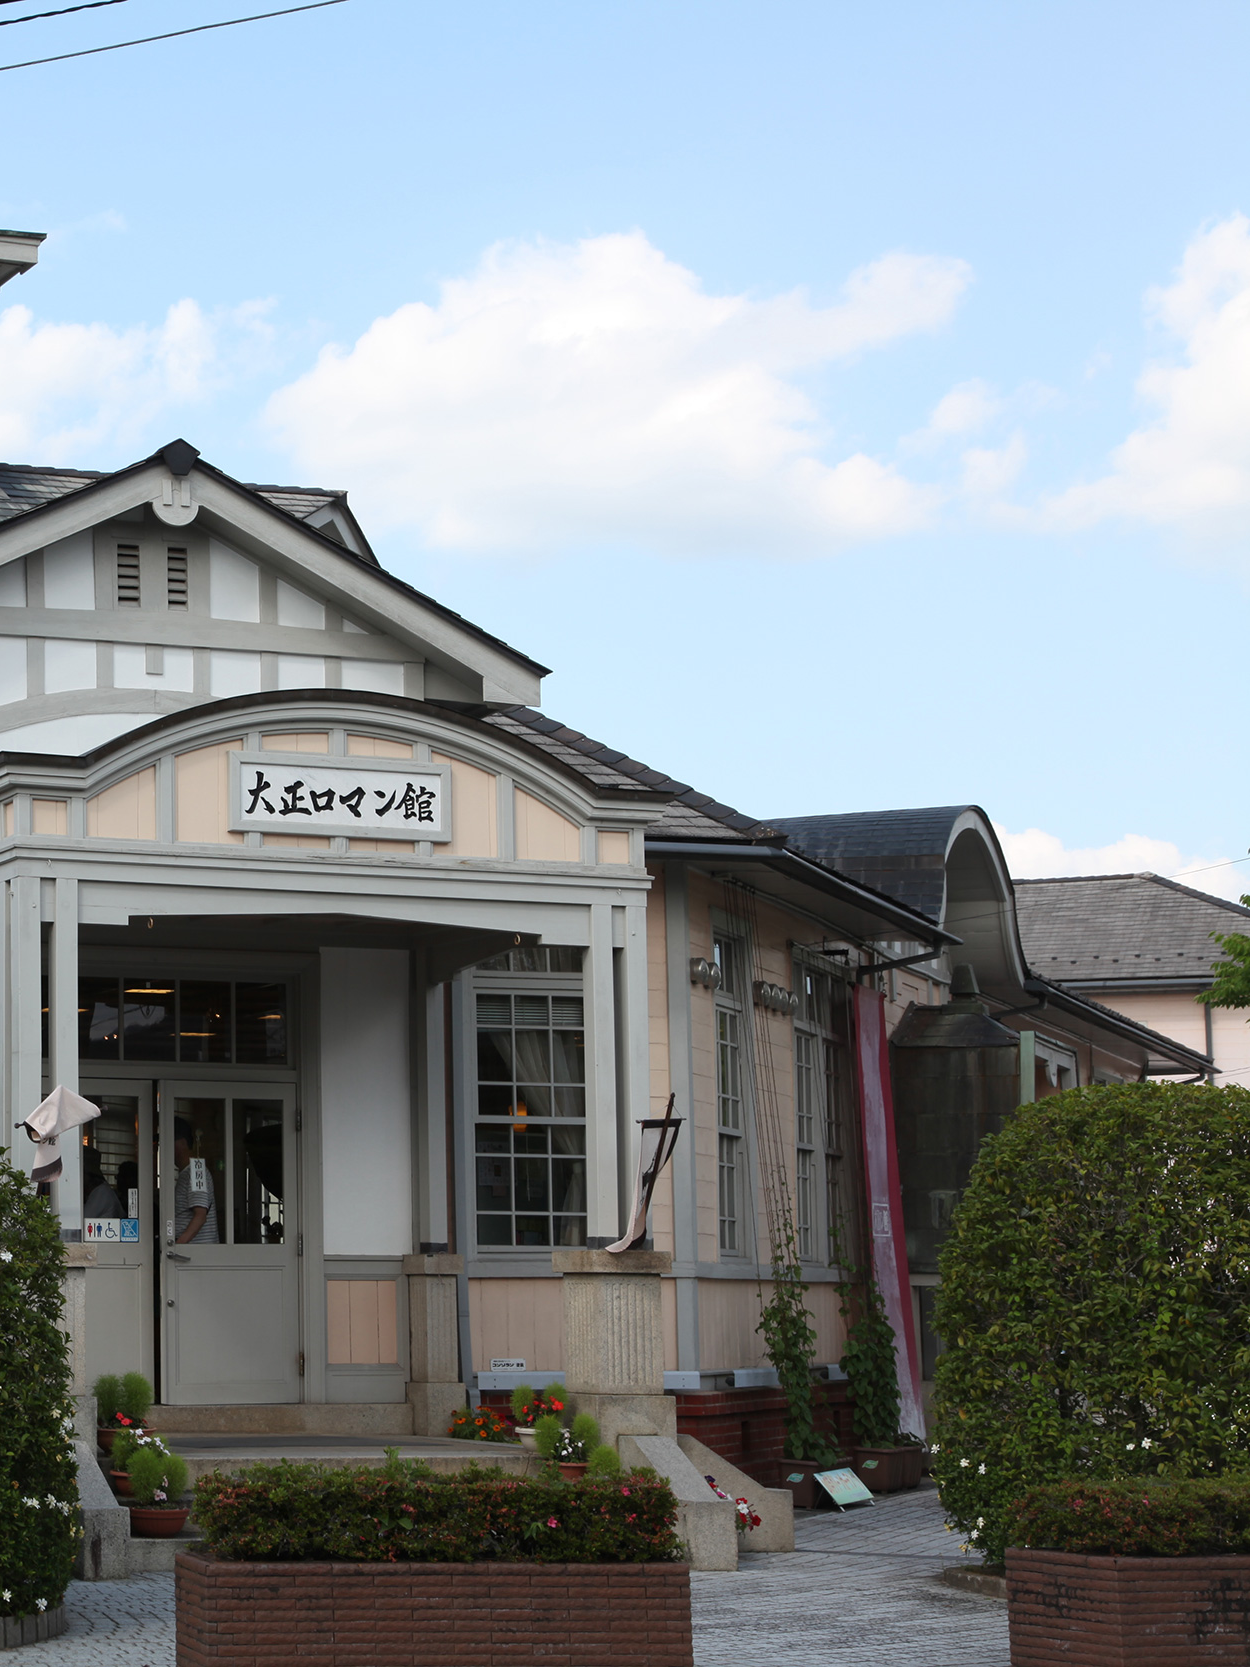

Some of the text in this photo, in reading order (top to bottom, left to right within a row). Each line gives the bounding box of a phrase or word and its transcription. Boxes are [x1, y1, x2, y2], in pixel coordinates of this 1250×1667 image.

[245, 771, 436, 823] 大正ロマン館
[194, 1160, 204, 1190] 冷房中
